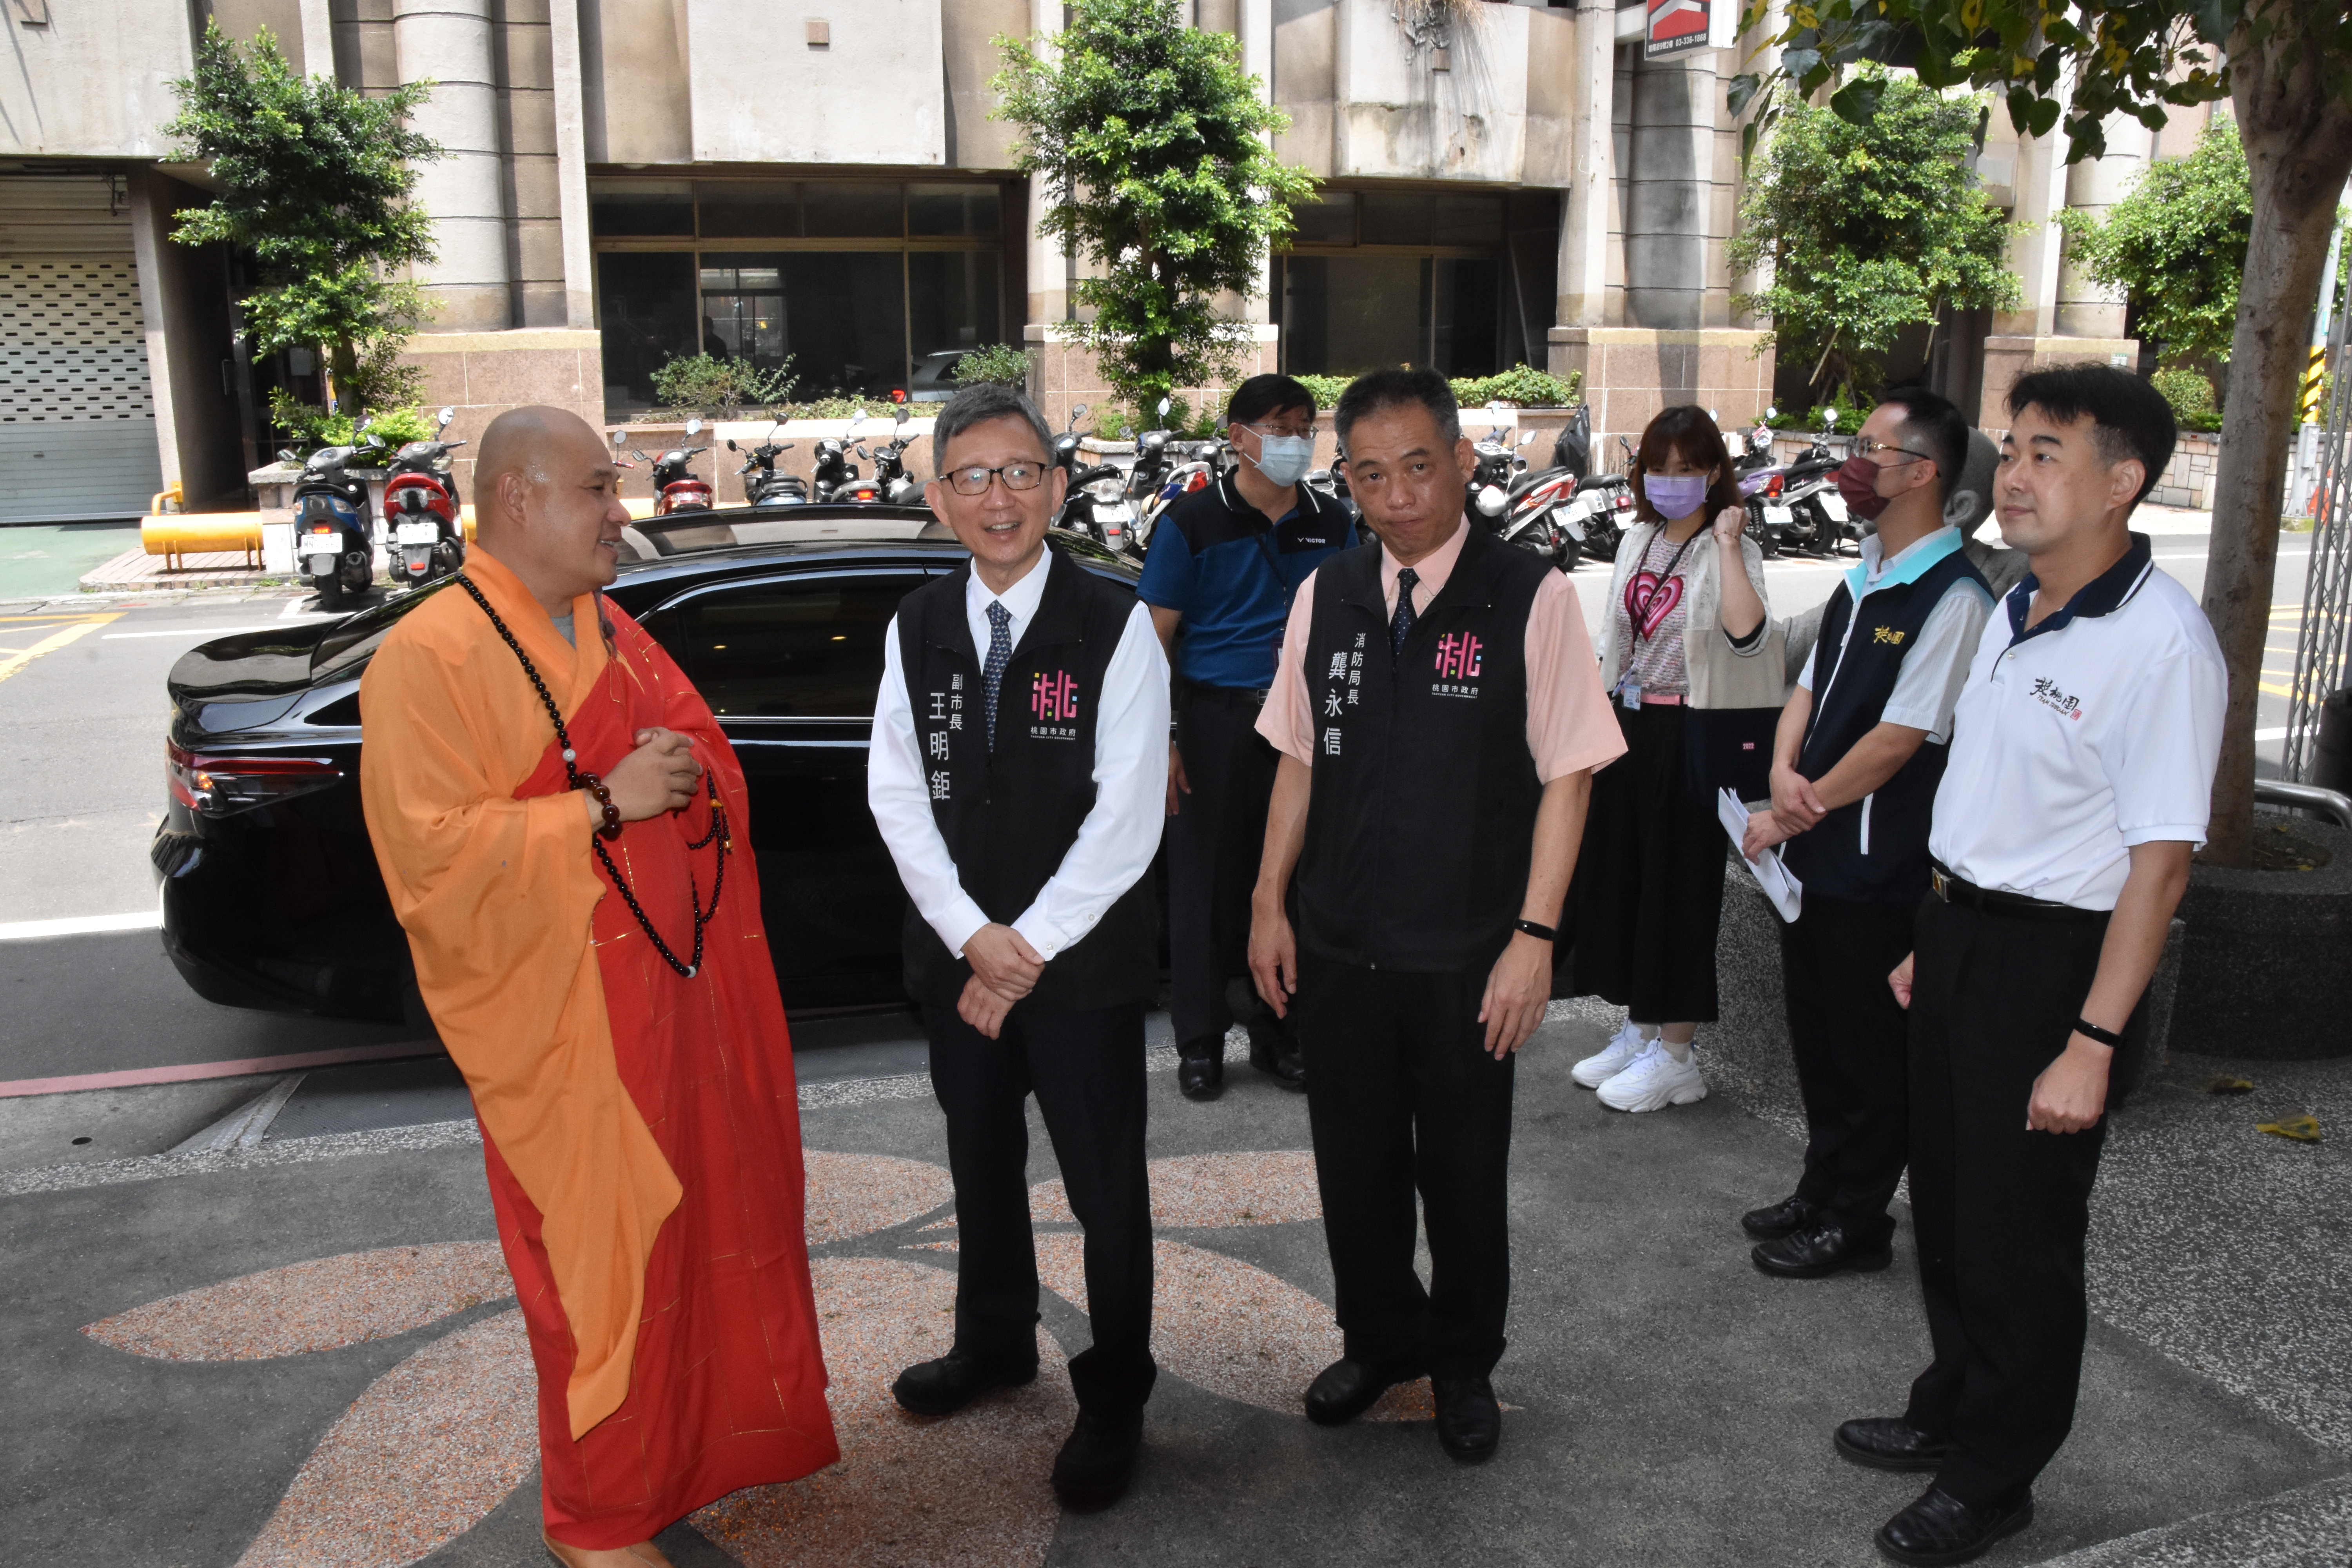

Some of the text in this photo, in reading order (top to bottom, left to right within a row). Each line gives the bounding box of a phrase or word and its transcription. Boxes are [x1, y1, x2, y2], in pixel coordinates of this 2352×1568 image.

[1675, 33, 1706, 46] 03-336-1868
[1347, 633, 1366, 705] 消防局長
[1432, 684, 1478, 695] 桃園市政府
[949, 674, 963, 730] 副市長
[1323, 651, 1348, 756] 龔永信
[929, 693, 951, 800] 王明鉅
[1031, 726, 1076, 737] 桃園市政府
